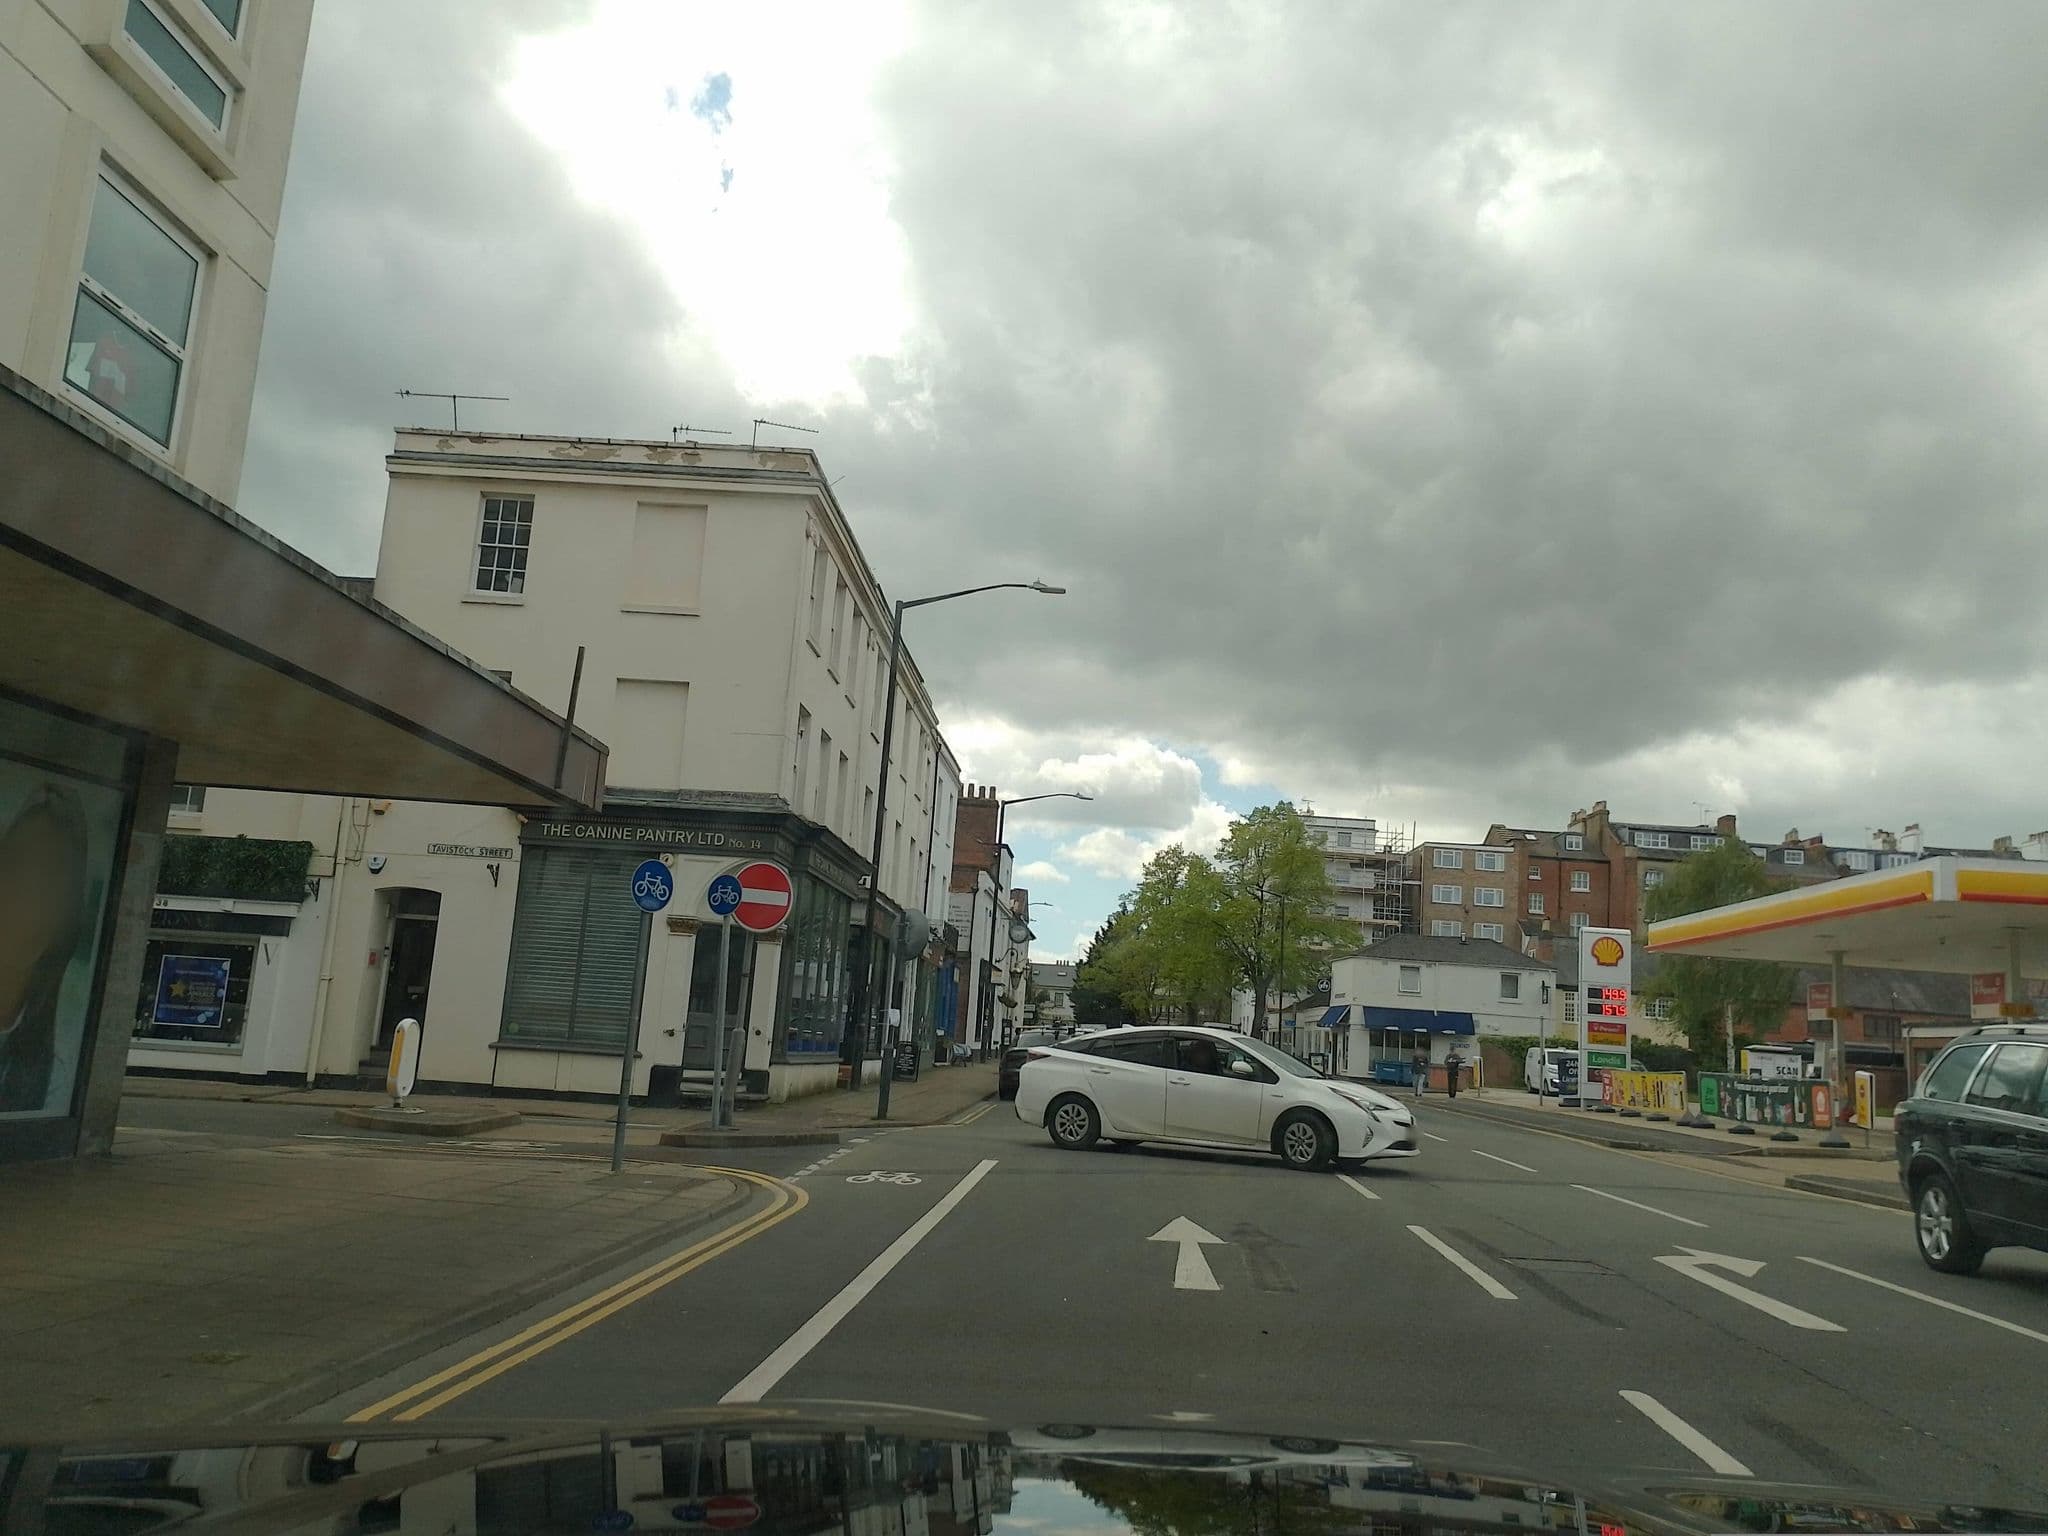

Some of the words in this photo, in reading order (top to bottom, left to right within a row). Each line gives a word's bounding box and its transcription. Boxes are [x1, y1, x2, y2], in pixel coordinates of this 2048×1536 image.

[541, 823, 571, 837] THE
[575, 825, 633, 840] CANINE
[636, 828, 694, 843] PANTRY
[698, 832, 725, 846] LTD
[751, 839, 761, 849] 14
[431, 844, 475, 855] TAVISTOCK
[479, 848, 509, 857] STREET
[1776, 1066, 1799, 1076] SCAN
